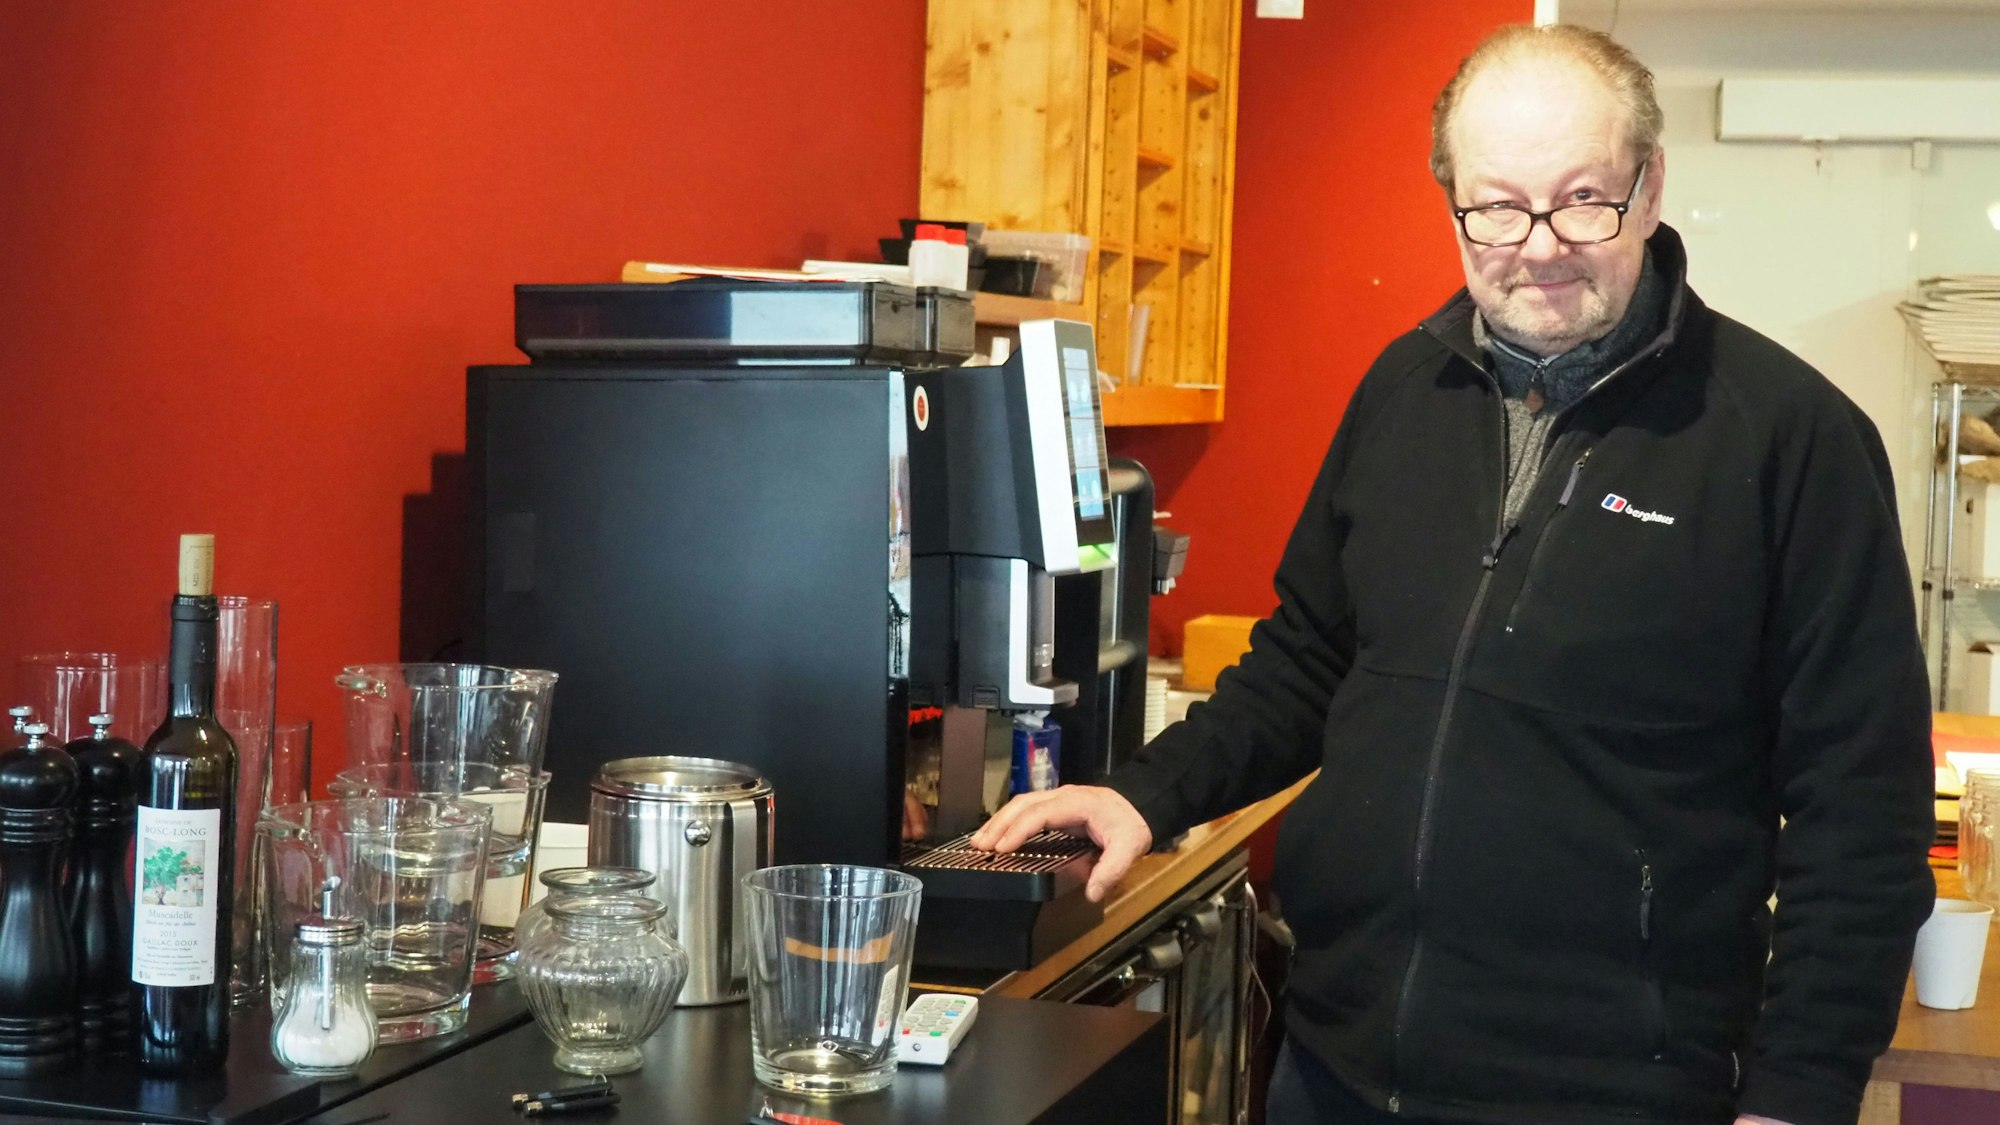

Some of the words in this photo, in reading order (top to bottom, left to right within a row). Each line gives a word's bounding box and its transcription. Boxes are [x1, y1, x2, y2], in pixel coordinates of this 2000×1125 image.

[1625, 504, 1675, 525] berghaus
[145, 825, 207, 837] BOSC-LONG
[148, 909, 193, 919] Muscadelle
[142, 937, 173, 946] GAILLAC
